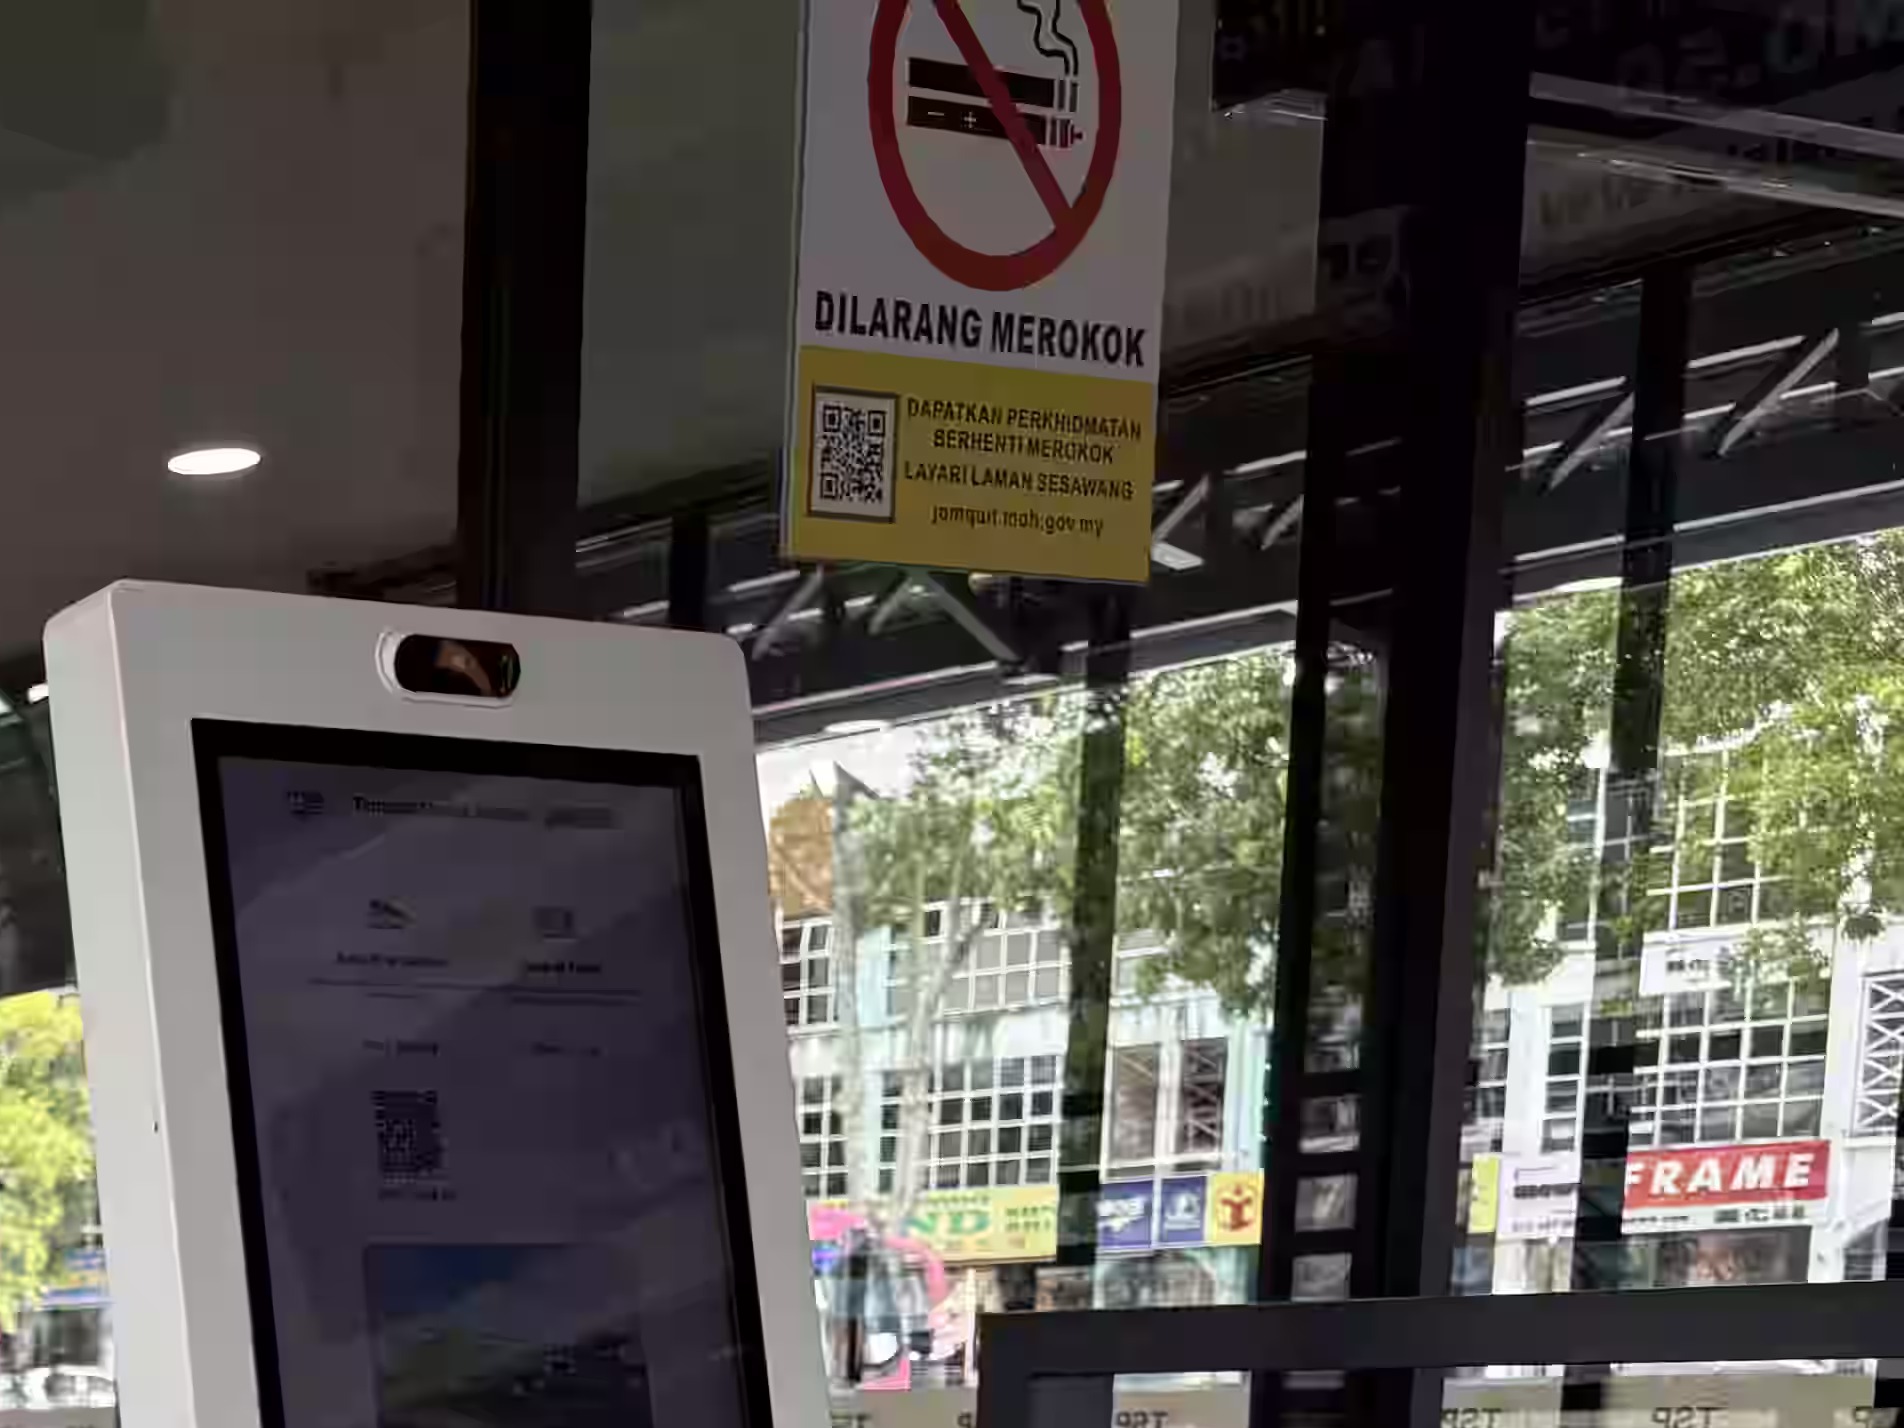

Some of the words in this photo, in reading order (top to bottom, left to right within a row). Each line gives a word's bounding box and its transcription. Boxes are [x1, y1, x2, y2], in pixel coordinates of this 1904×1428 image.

[815, 289, 982, 350] DILARANG
[991, 311, 1144, 367] MEROKOK
[908, 398, 1002, 424] DAPATKAN
[1007, 408, 1141, 440] PERKHIDMATAN
[933, 429, 1023, 455] BERHENTI
[1028, 440, 1114, 464] MEROKOK
[905, 461, 968, 485] LAYARI
[972, 466, 1032, 491] LAMAN
[1038, 472, 1134, 500] SESAWANG
[1625, 1152, 1815, 1196] FRAME
